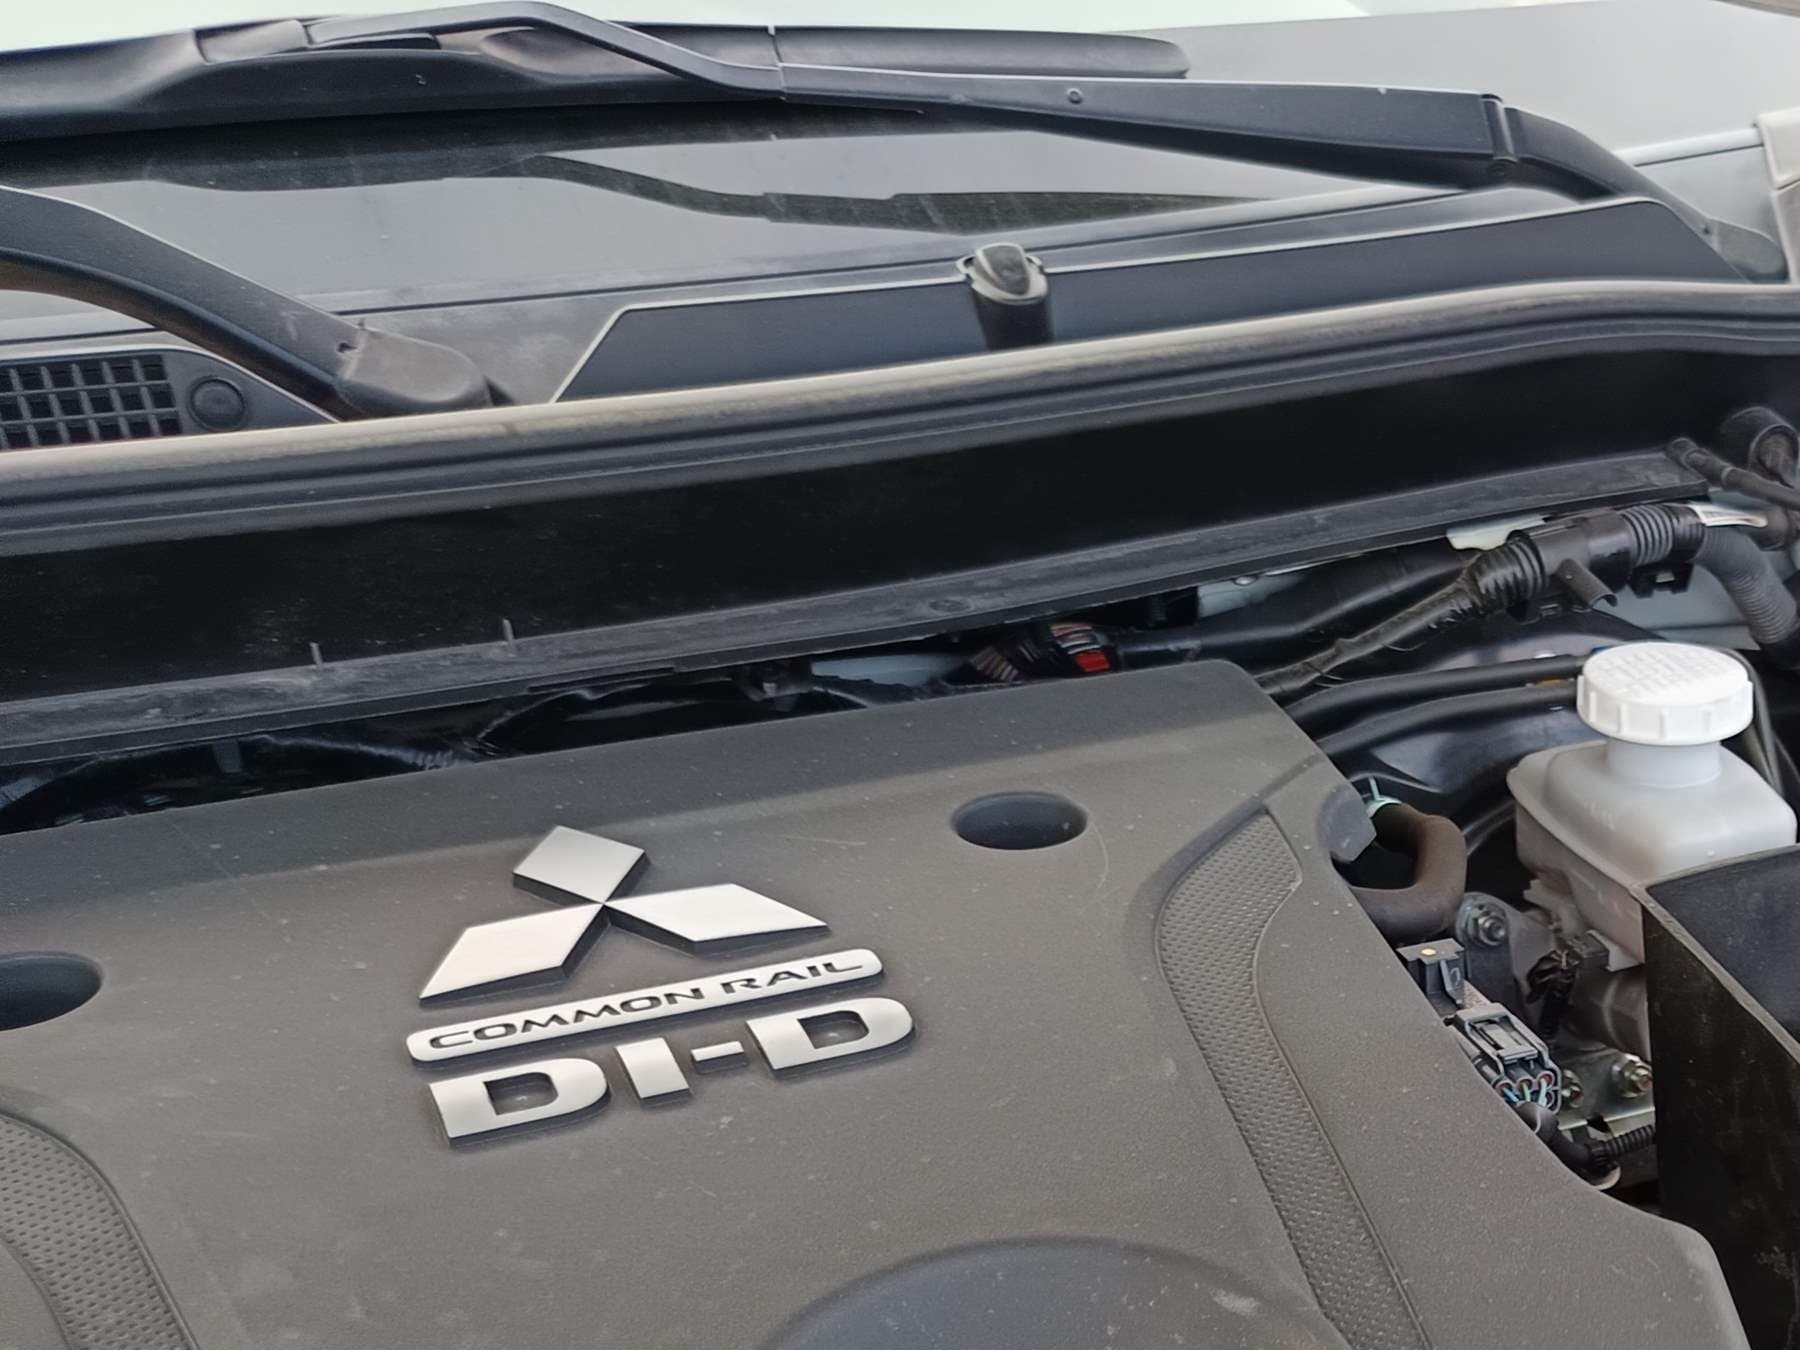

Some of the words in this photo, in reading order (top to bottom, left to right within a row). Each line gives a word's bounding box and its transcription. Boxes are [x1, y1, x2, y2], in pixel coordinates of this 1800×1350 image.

[429, 987, 704, 1049] COMMON
[720, 962, 863, 994] RAIL
[428, 997, 914, 1142] DI-D
